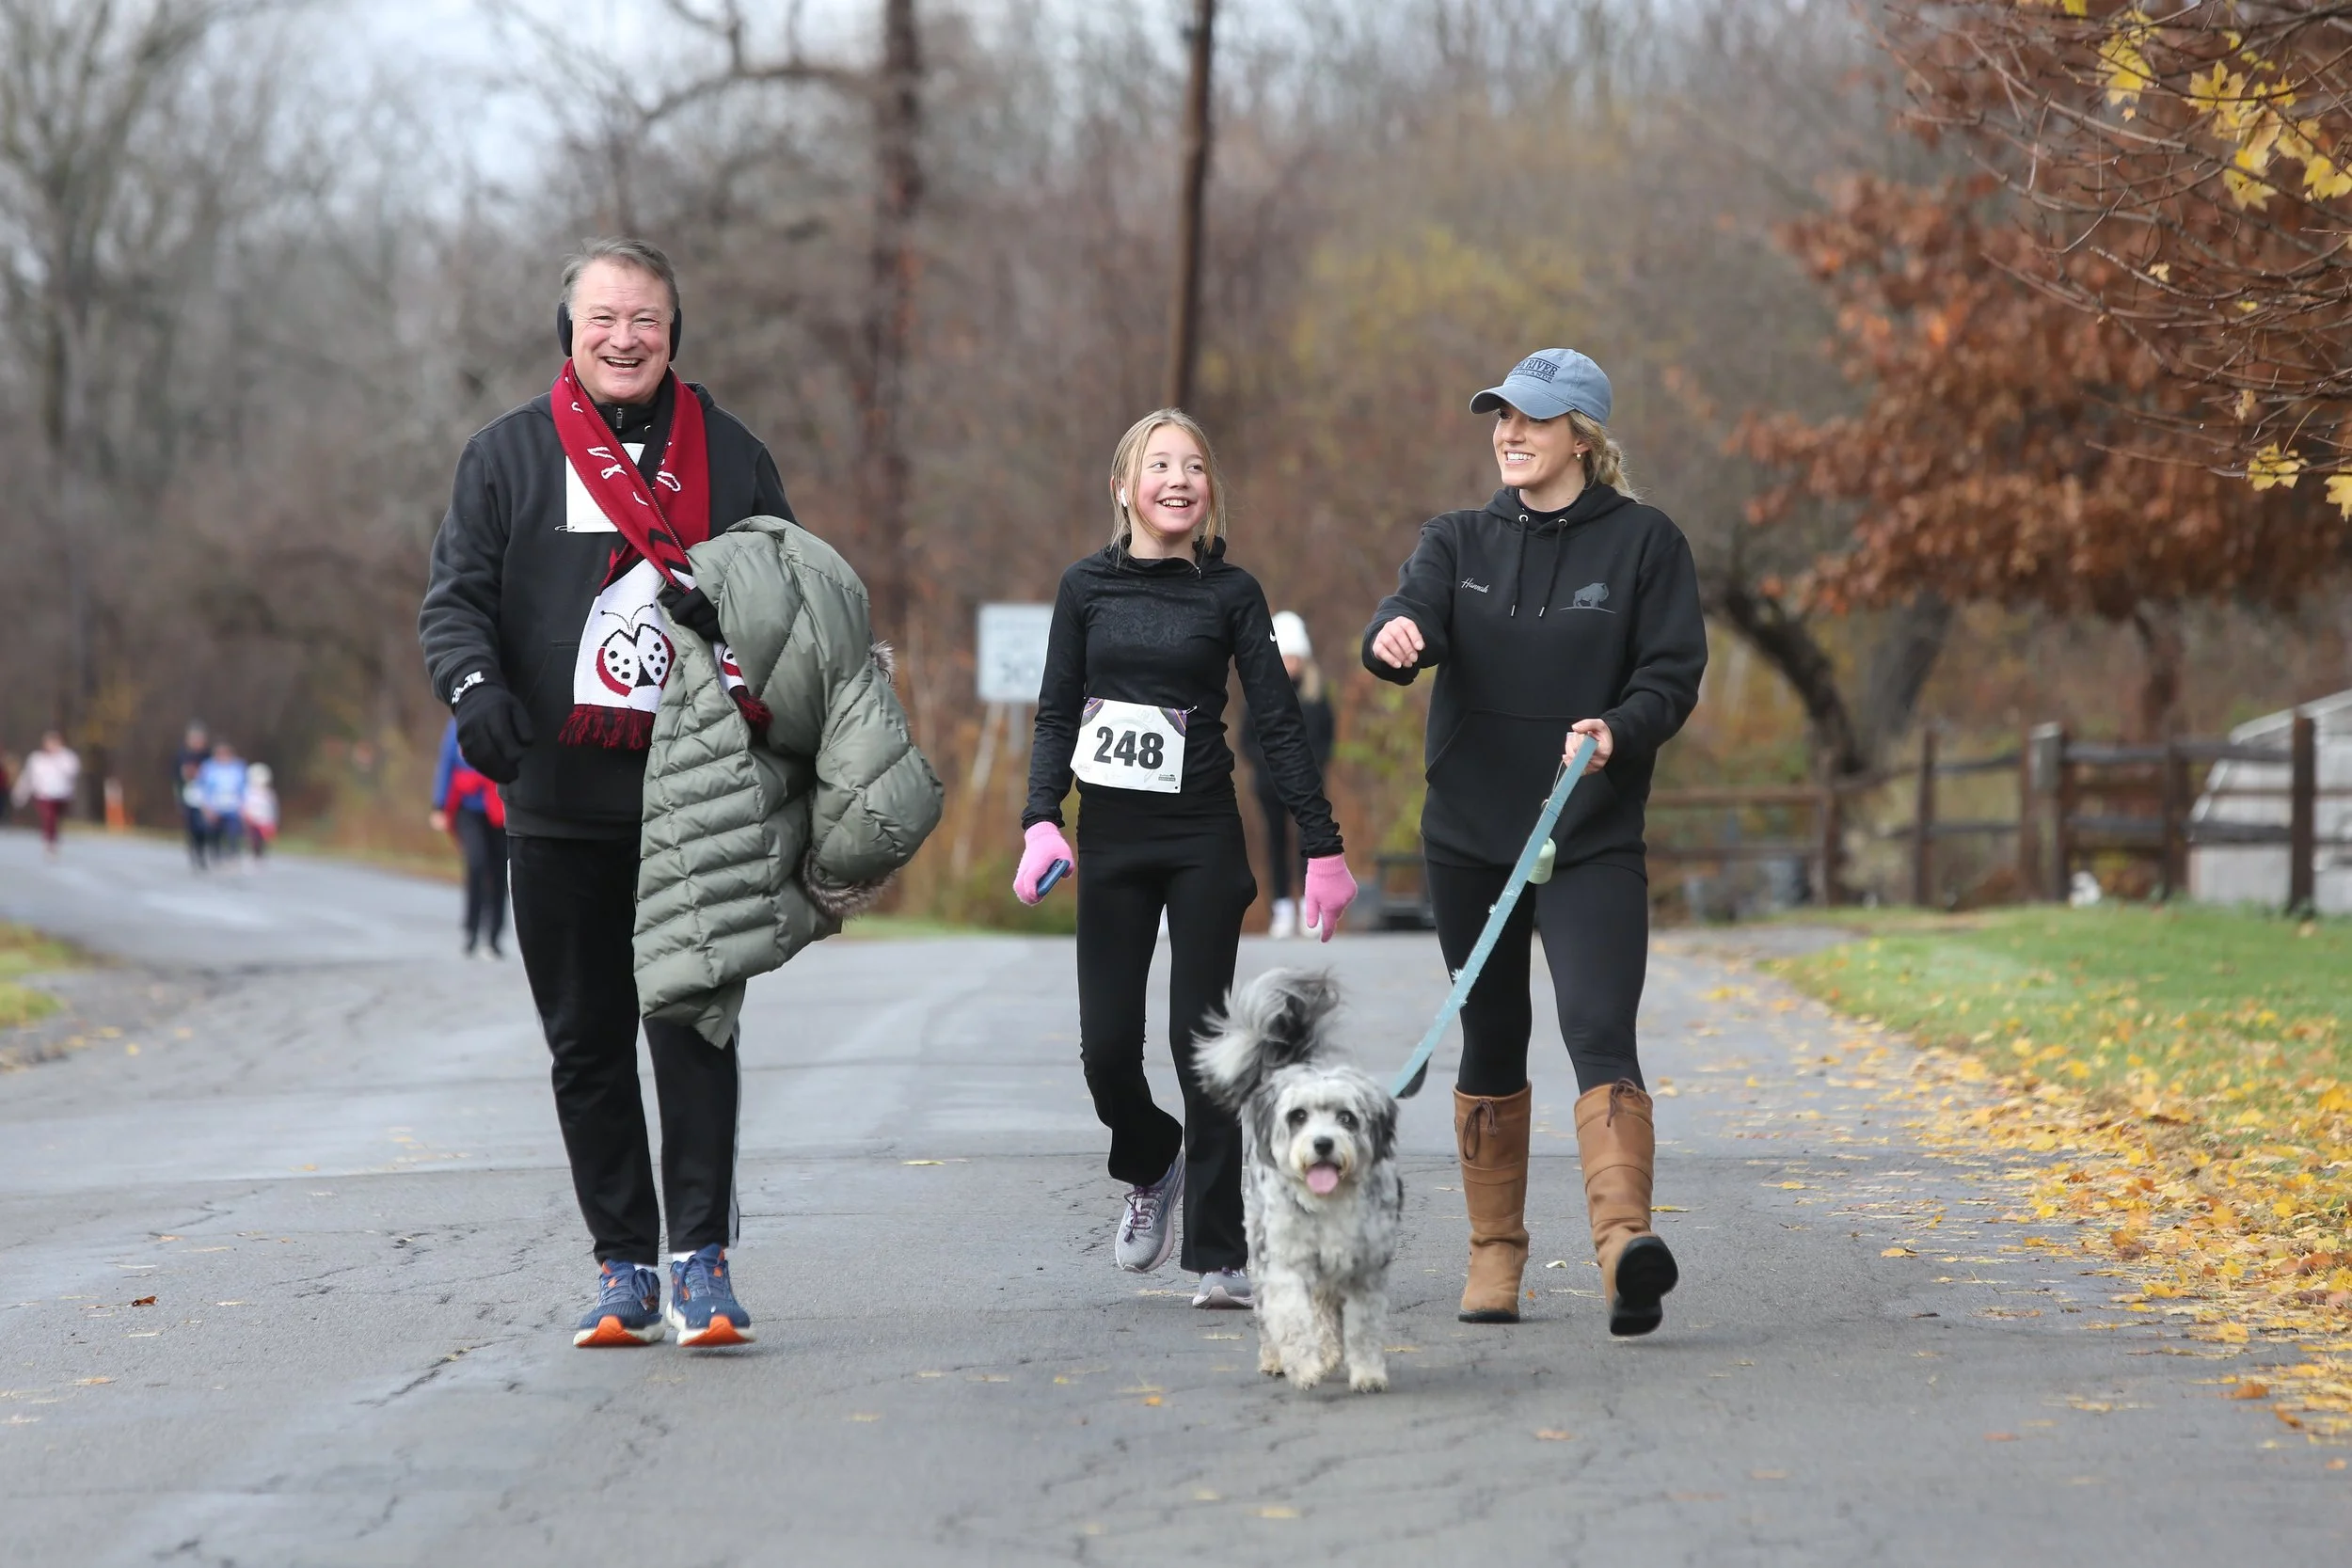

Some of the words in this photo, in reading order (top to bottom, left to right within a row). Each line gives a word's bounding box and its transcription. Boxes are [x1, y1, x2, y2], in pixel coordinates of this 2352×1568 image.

[1525, 359, 1558, 375] RIVER
[1461, 577, 1489, 594] Hannah
[1093, 725, 1165, 770] 248
